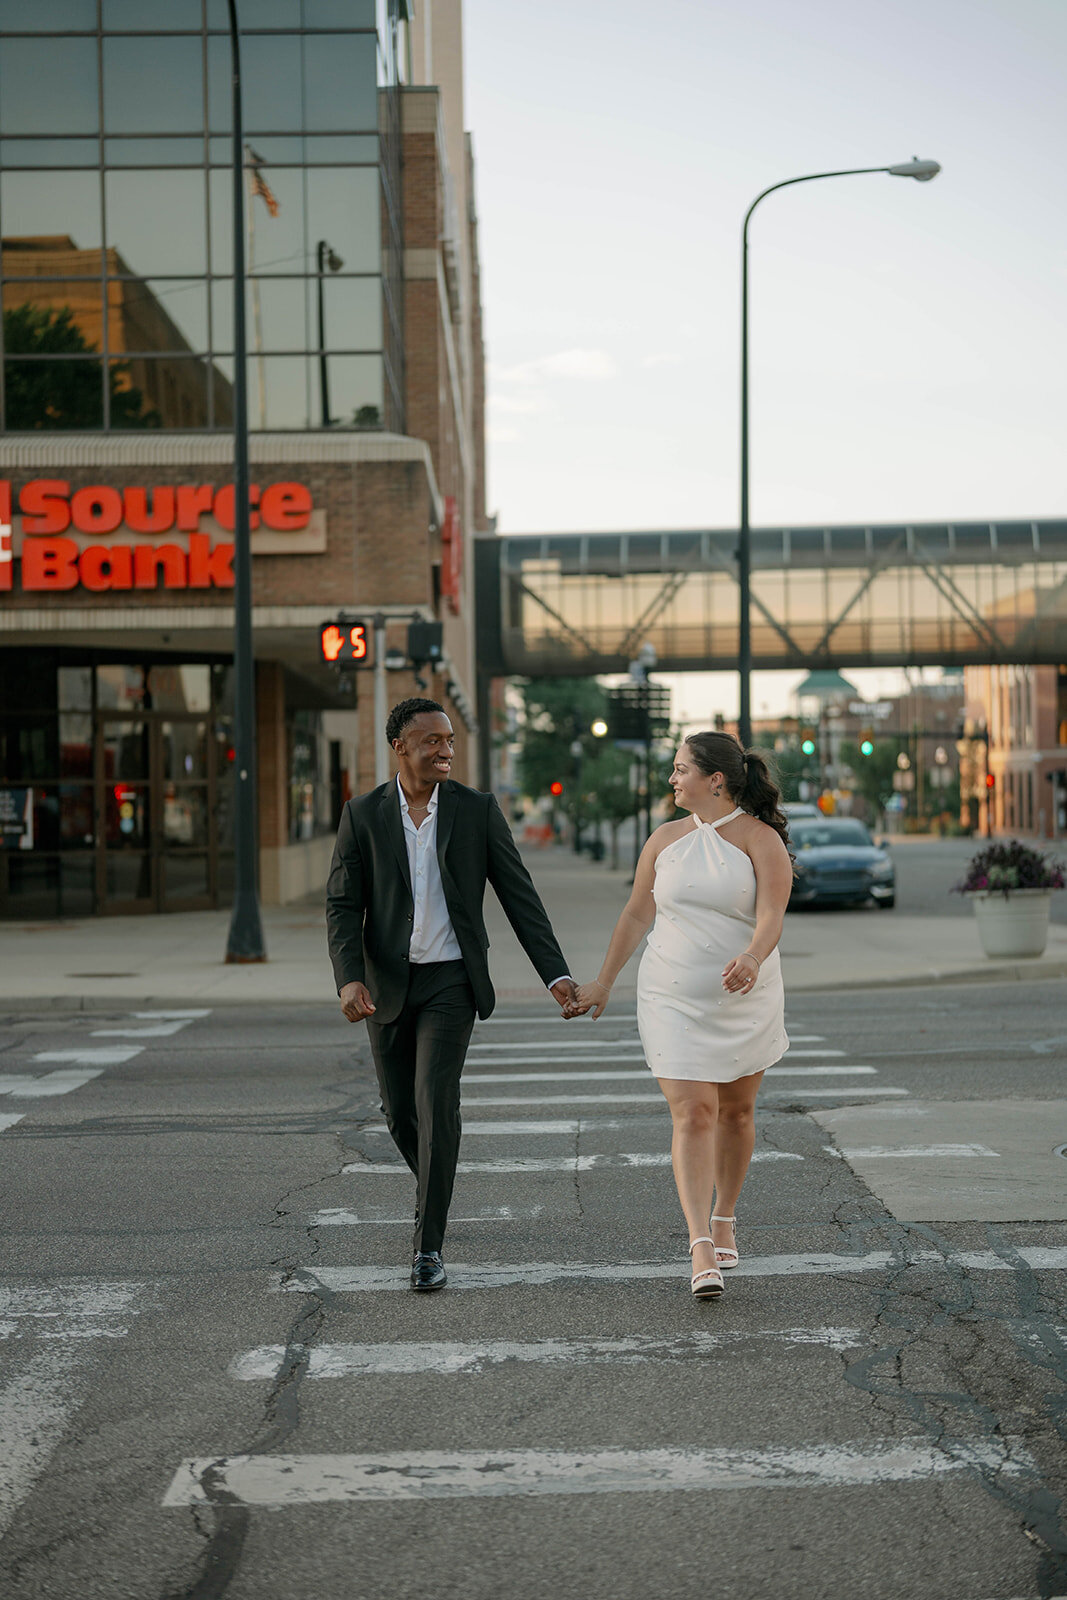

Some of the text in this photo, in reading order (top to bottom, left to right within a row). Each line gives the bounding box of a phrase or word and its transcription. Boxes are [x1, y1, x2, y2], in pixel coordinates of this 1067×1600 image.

[19, 478, 313, 535] Source
[21, 533, 236, 591] Bank
[350, 626, 367, 658] 5
